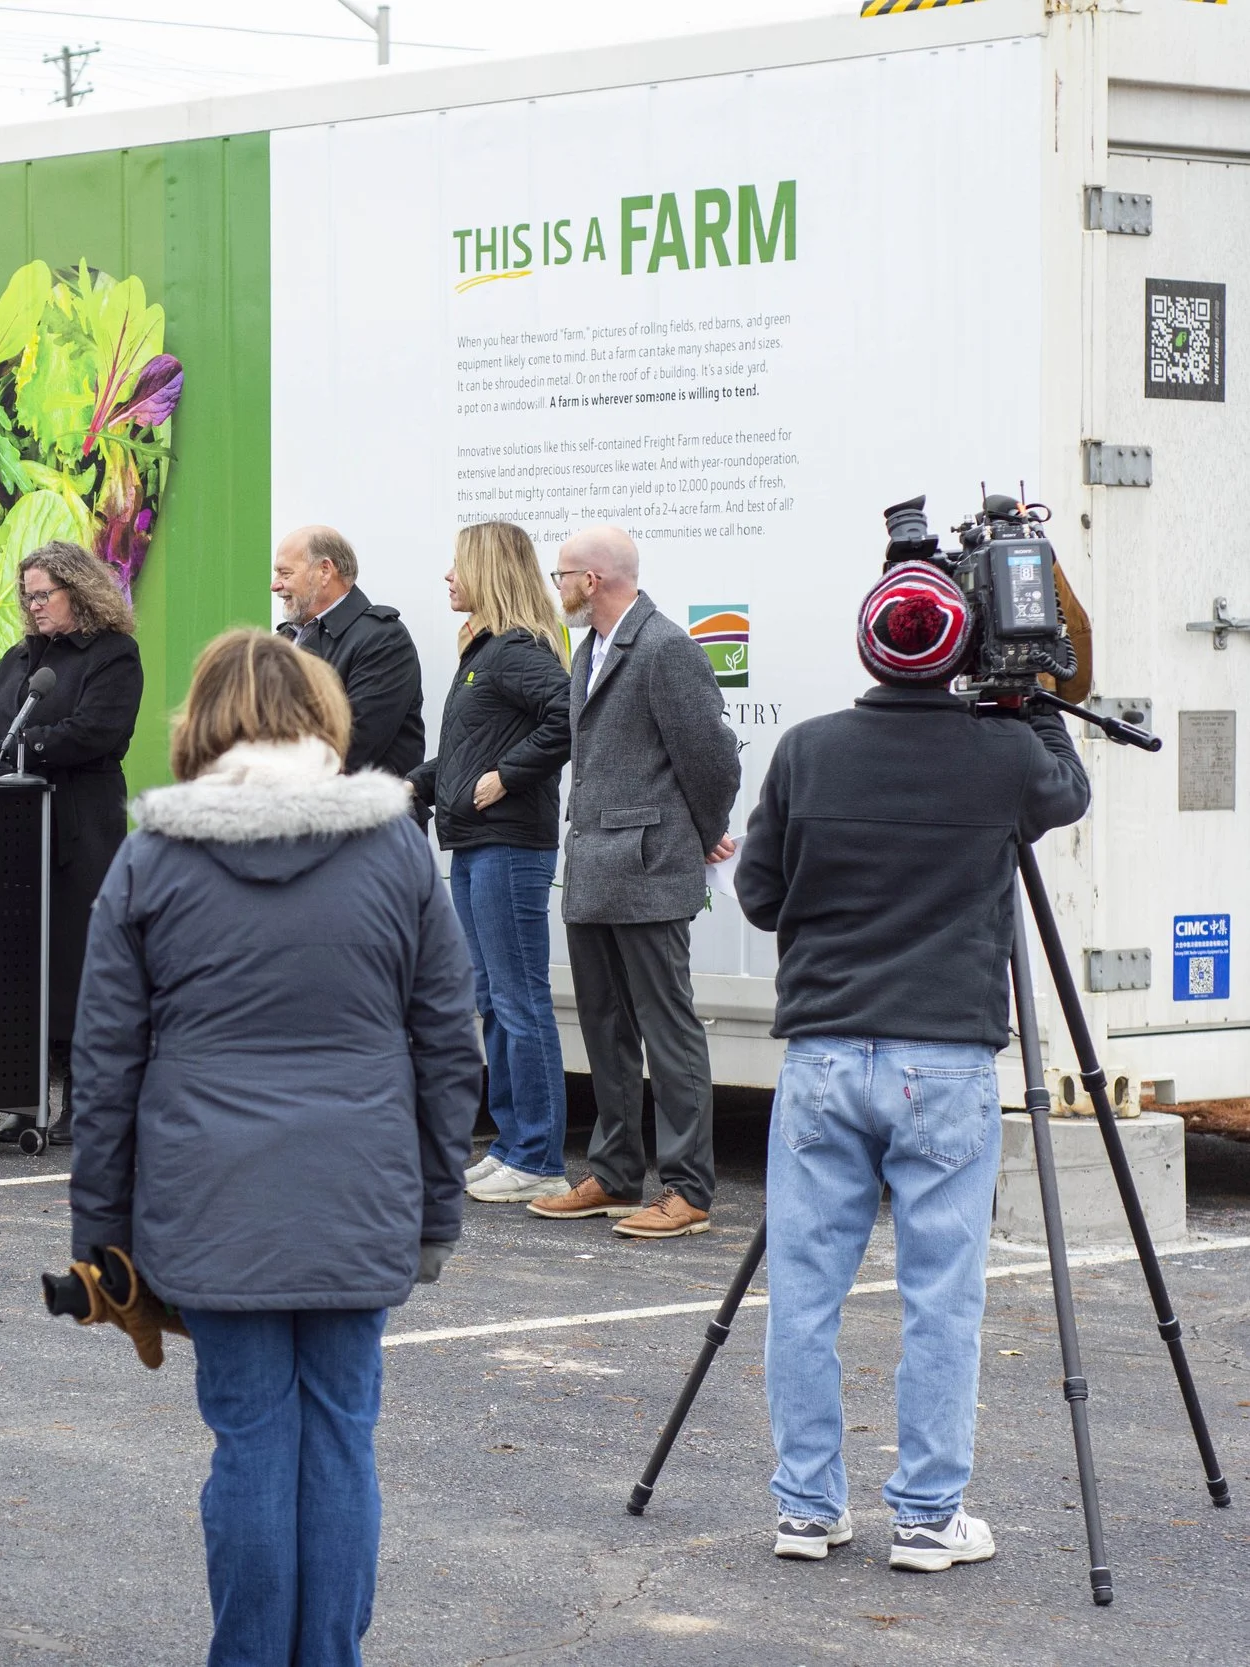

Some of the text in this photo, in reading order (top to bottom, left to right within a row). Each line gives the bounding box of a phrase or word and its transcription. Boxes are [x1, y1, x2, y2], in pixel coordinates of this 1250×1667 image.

[453, 179, 797, 275] THIS IS A FARM
[457, 336, 482, 348] When
[483, 337, 499, 350] you
[500, 333, 519, 344] hear
[520, 331, 536, 344] the
[535, 329, 558, 342] word
[592, 327, 627, 341] pictures
[628, 322, 639, 335] of
[640, 322, 668, 336] rolling
[670, 319, 697, 332] fields,
[698, 317, 714, 330] red
[715, 317, 743, 329] barns,
[746, 313, 763, 327] and
[764, 315, 791, 329] green
[457, 337, 783, 372] equipment likely come to mind. But a farm can take many shapes and sizes.
[457, 381, 464, 392] It
[465, 382, 481, 391] can
[482, 378, 493, 390] be
[495, 376, 536, 389] shrouded
[536, 376, 545, 386] in
[576, 372, 586, 384] Or
[588, 374, 600, 383] on
[602, 370, 617, 382] the
[619, 368, 639, 381] roof
[640, 367, 651, 380] of
[660, 365, 699, 381] building.
[701, 364, 715, 376] It's
[717, 366, 723, 375] a
[724, 361, 744, 375] side
[746, 360, 768, 377] yard,
[457, 405, 462, 414] a
[464, 403, 479, 416] pot
[480, 404, 492, 412] on
[493, 403, 499, 411] a
[549, 396, 556, 408] A
[558, 395, 579, 407] farm
[581, 394, 589, 406] is
[591, 393, 633, 405] wherever
[635, 392, 676, 403] someone
[678, 388, 686, 400] is
[688, 386, 720, 402] willing
[722, 387, 733, 398] to
[735, 383, 760, 397] tend.
[457, 428, 792, 456] Innovative solutions like this self-contained Freight Farm reduce the need for
[457, 467, 496, 479] extensive
[498, 465, 516, 477] land
[517, 464, 535, 477] and
[535, 464, 571, 478] precious
[572, 464, 613, 473] resources
[615, 460, 630, 472] like
[660, 457, 678, 469] And
[680, 456, 699, 469] with
[701, 453, 753, 471] year-round
[752, 452, 799, 468] operation,
[457, 475, 786, 501] this small but mighty container farm can yield up to 12,000 pounds of fresh,
[457, 510, 497, 522] nutritious
[499, 508, 534, 523] produce
[534, 507, 570, 522] annually
[581, 506, 595, 518] the
[597, 504, 642, 520] equivalent
[643, 503, 655, 516] of
[655, 507, 661, 515] a
[662, 503, 677, 515] 2-4
[679, 505, 698, 514] acre
[725, 500, 744, 512] And
[747, 499, 765, 512] best
[767, 498, 777, 511] of
[779, 498, 794, 511] all?
[628, 526, 643, 538] the
[645, 526, 701, 538] communities
[704, 528, 718, 536] we
[719, 523, 735, 536] call
[736, 523, 766, 535] home.
[722, 703, 783, 724] STRY
[1175, 920, 1209, 937] CIMC
[1209, 919, 1228, 936] 中集
